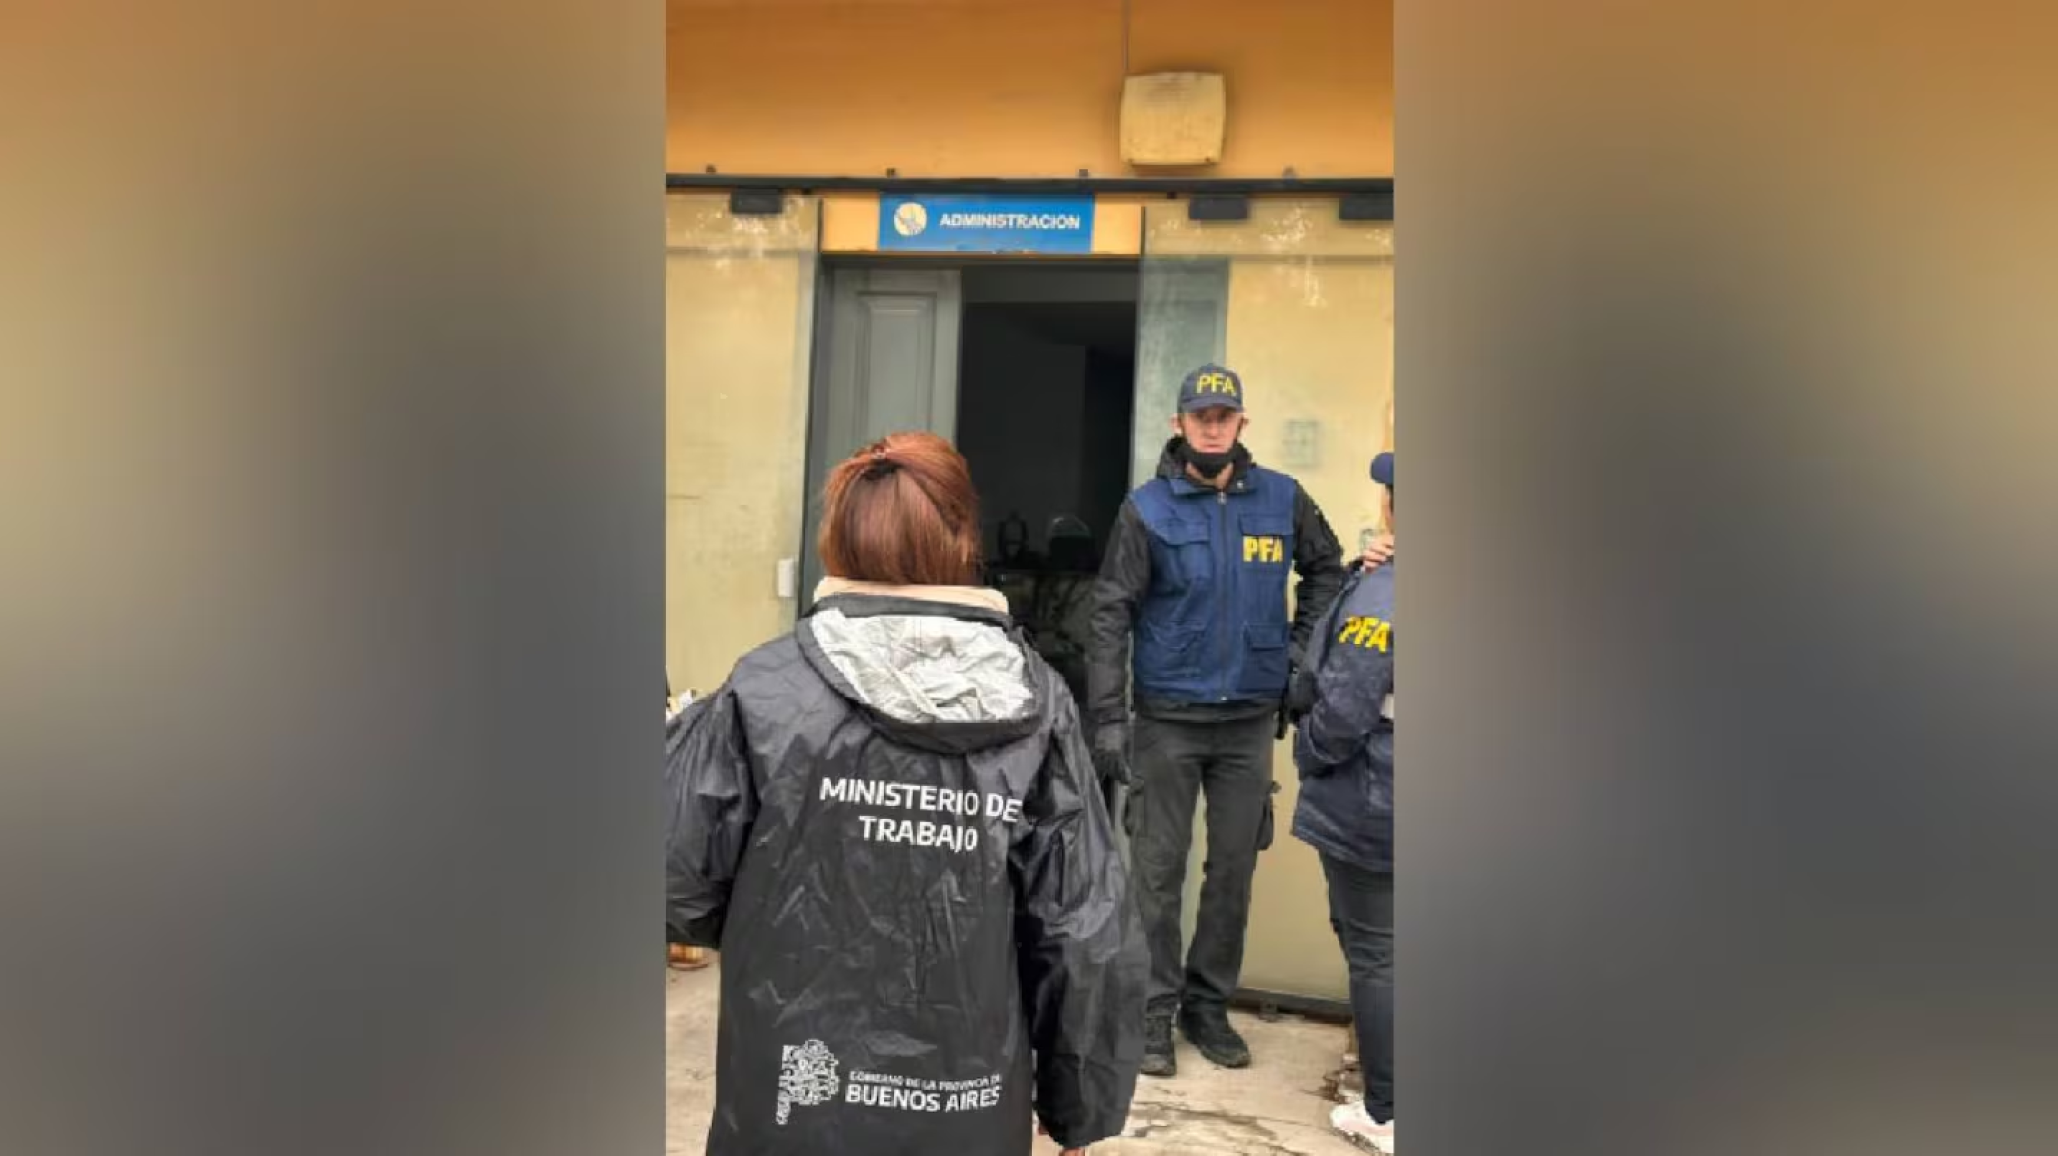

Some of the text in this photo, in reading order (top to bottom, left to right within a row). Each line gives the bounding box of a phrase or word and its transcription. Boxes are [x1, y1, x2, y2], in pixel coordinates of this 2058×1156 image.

[939, 213, 1080, 230] ADMINISTRACION
[1197, 373, 1237, 396] PFA
[1243, 536, 1284, 562] PFA
[1339, 616, 1390, 652] PFA
[819, 777, 1023, 823] MINISTERIO DE
[858, 815, 978, 853] TRABAJO
[845, 1084, 1001, 1113] BUENOS AIRES
